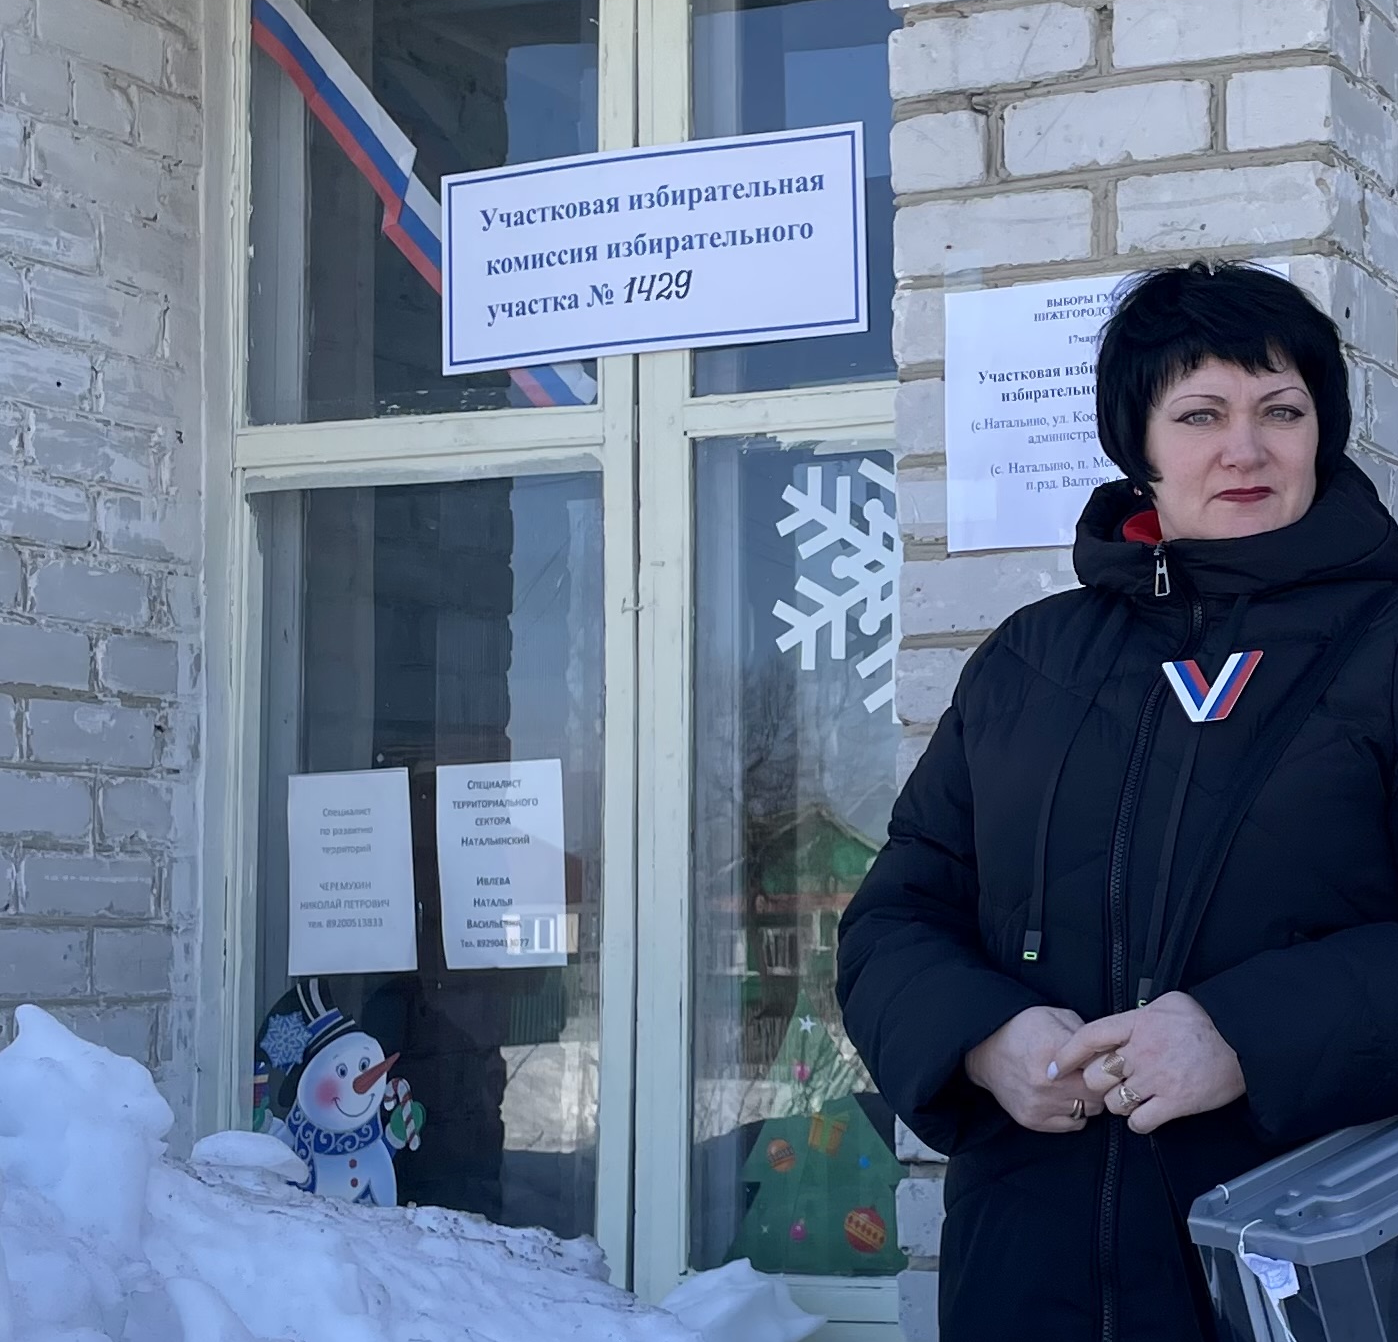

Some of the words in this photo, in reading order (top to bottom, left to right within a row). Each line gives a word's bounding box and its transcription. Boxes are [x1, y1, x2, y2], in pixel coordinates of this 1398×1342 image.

[480, 195, 620, 233] Участковая
[628, 172, 825, 213] избирательная
[486, 244, 598, 276] комиссия
[607, 219, 814, 260] избирательного
[487, 293, 579, 327] участка
[586, 283, 614, 308] №
[623, 269, 693, 304] 1429
[1046, 295, 1093, 308] ВЫБОРЫ
[978, 367, 1061, 385] Участковая
[1052, 414, 1070, 427] ул.
[1008, 461, 1074, 474] Натальино,
[1077, 460, 1089, 469] п.
[452, 797, 539, 810] ТЕРРИТОРИАЛЬНОГО
[475, 817, 511, 826] СЕКТОРА
[300, 898, 342, 910] НИКОЛАЙ
[343, 898, 390, 909] ПЕТРОВИЧ
